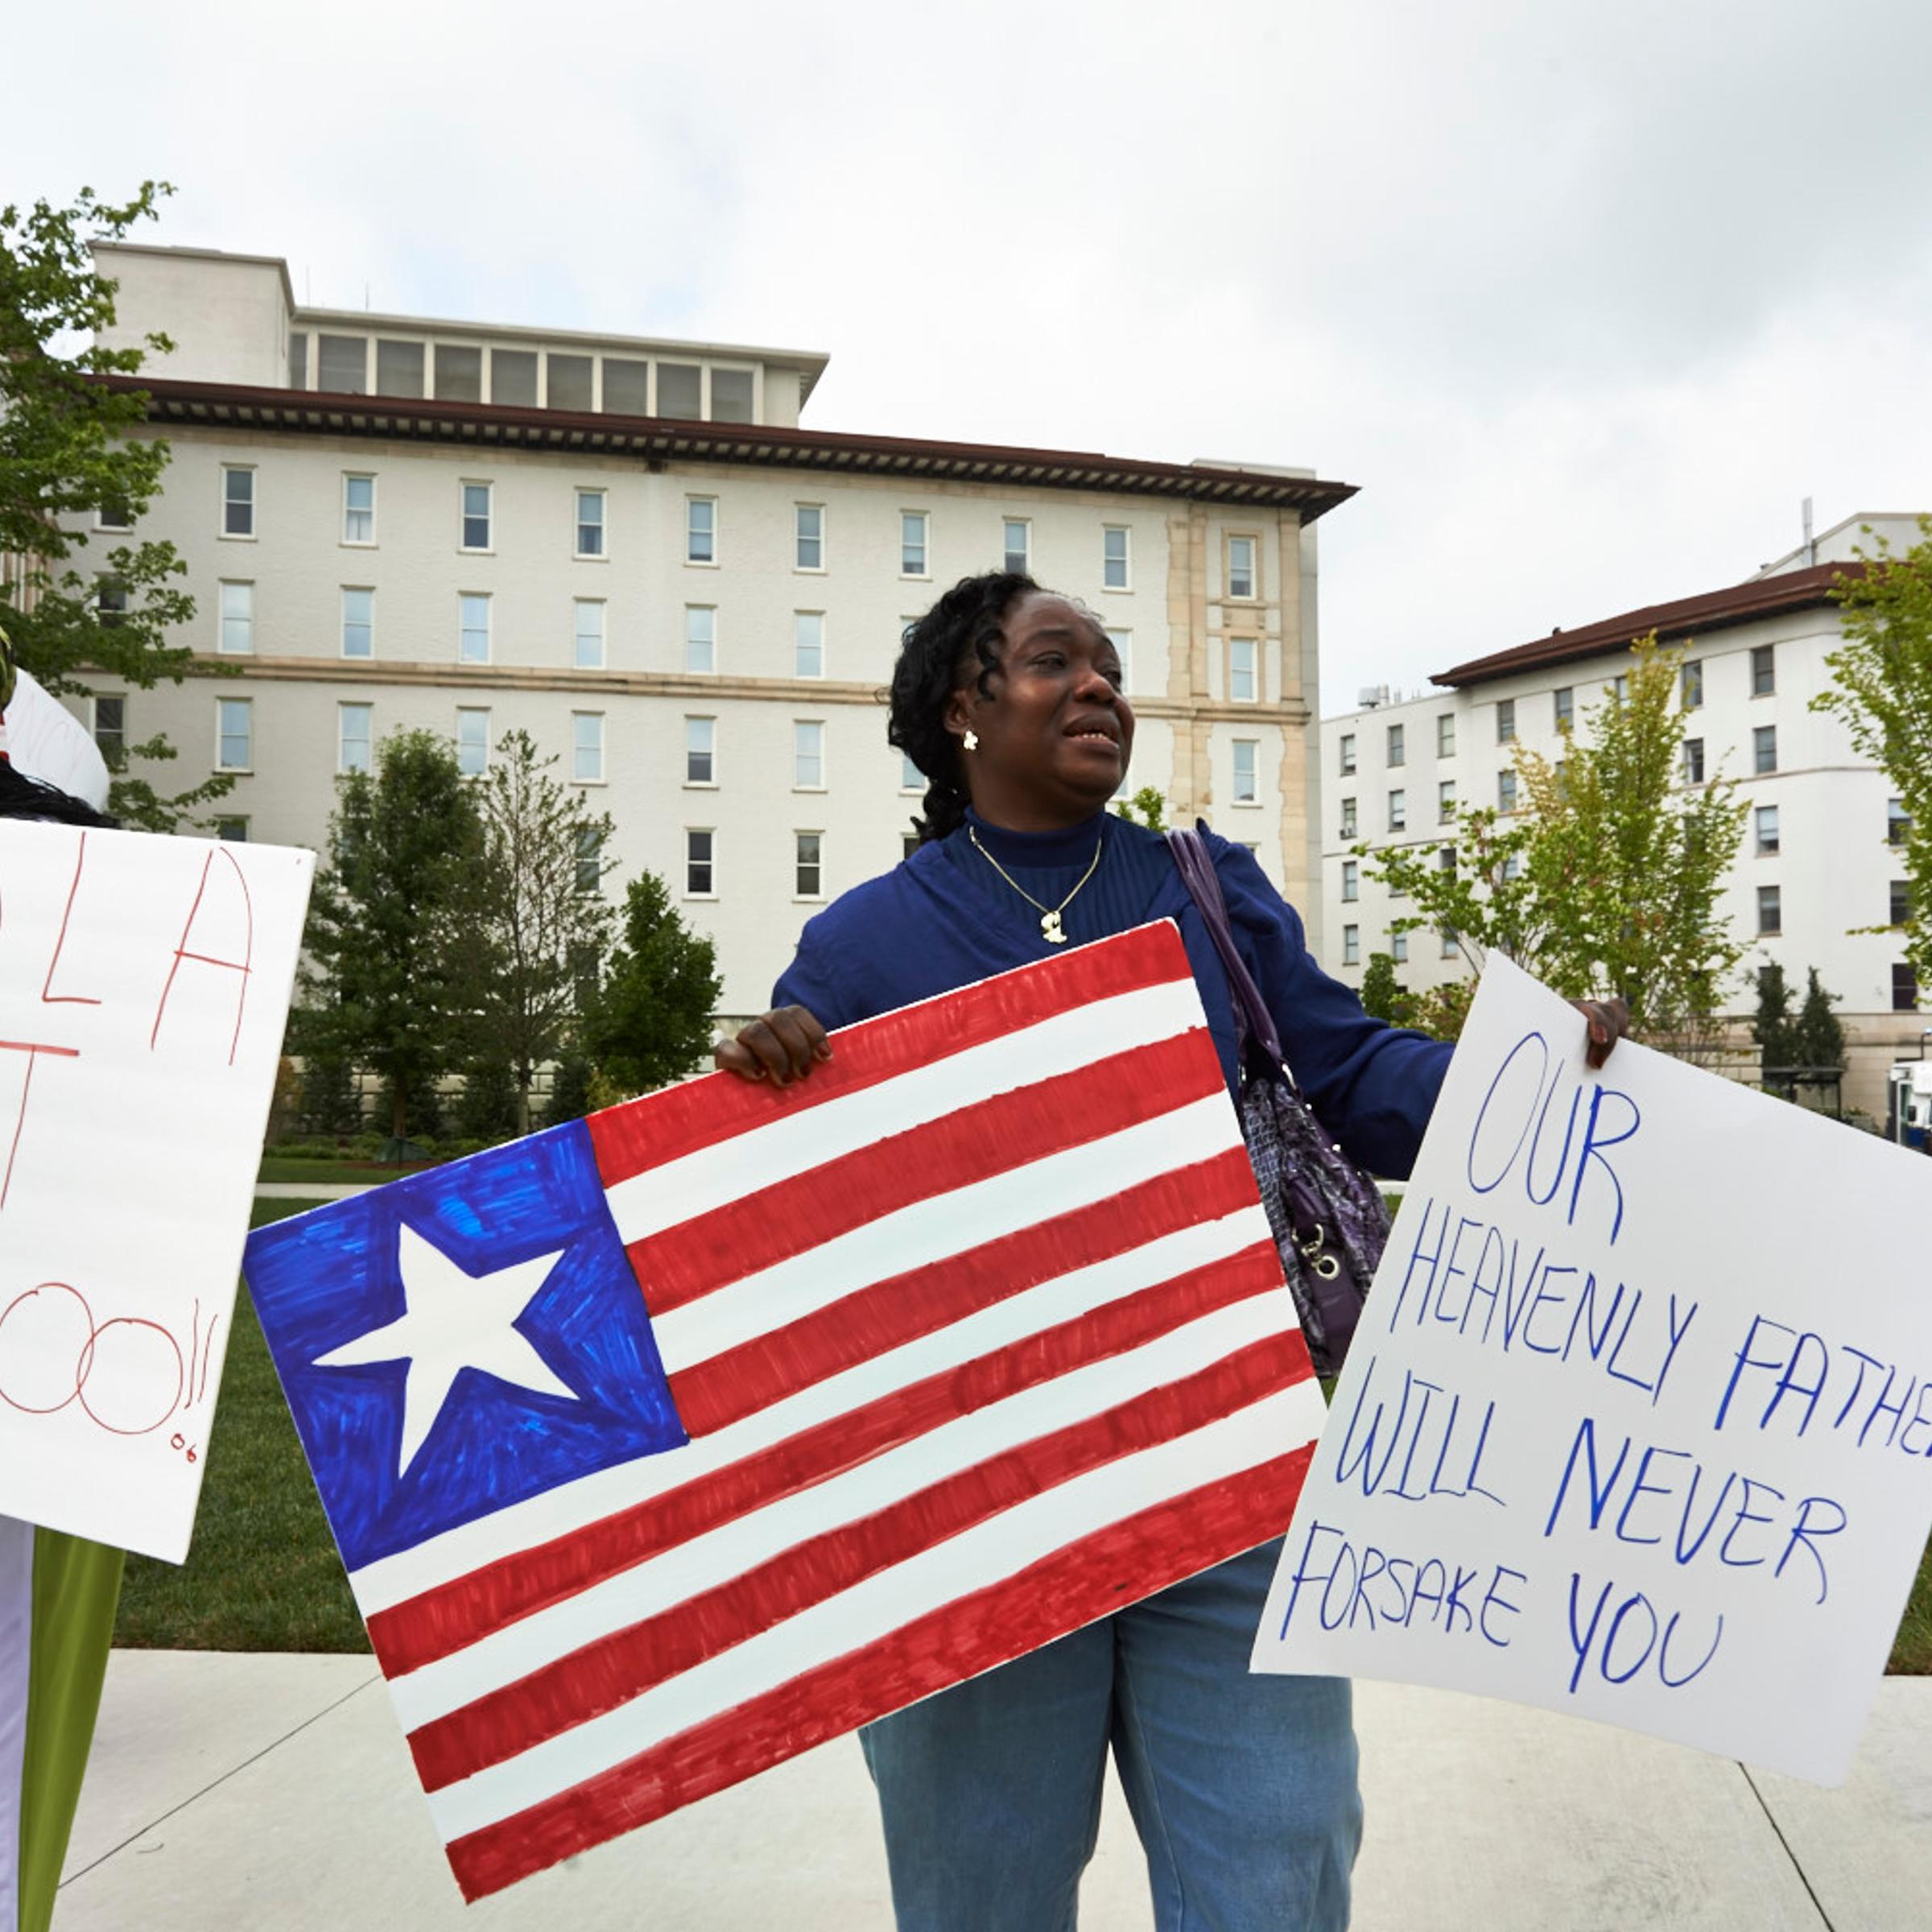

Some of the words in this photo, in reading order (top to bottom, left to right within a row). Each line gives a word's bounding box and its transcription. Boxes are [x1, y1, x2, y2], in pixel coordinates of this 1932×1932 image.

[0, 831, 253, 1067] LA
[1466, 1032, 1641, 1245] OUR
[1390, 1196, 1699, 1406] HEAVENLY
[1714, 1314, 1932, 1458] FATHE
[1335, 1355, 1507, 1506] WILL
[1544, 1417, 1847, 1604] NEVER
[1280, 1521, 1528, 1647] FORSAKE
[1568, 1572, 1724, 1695] YOU
